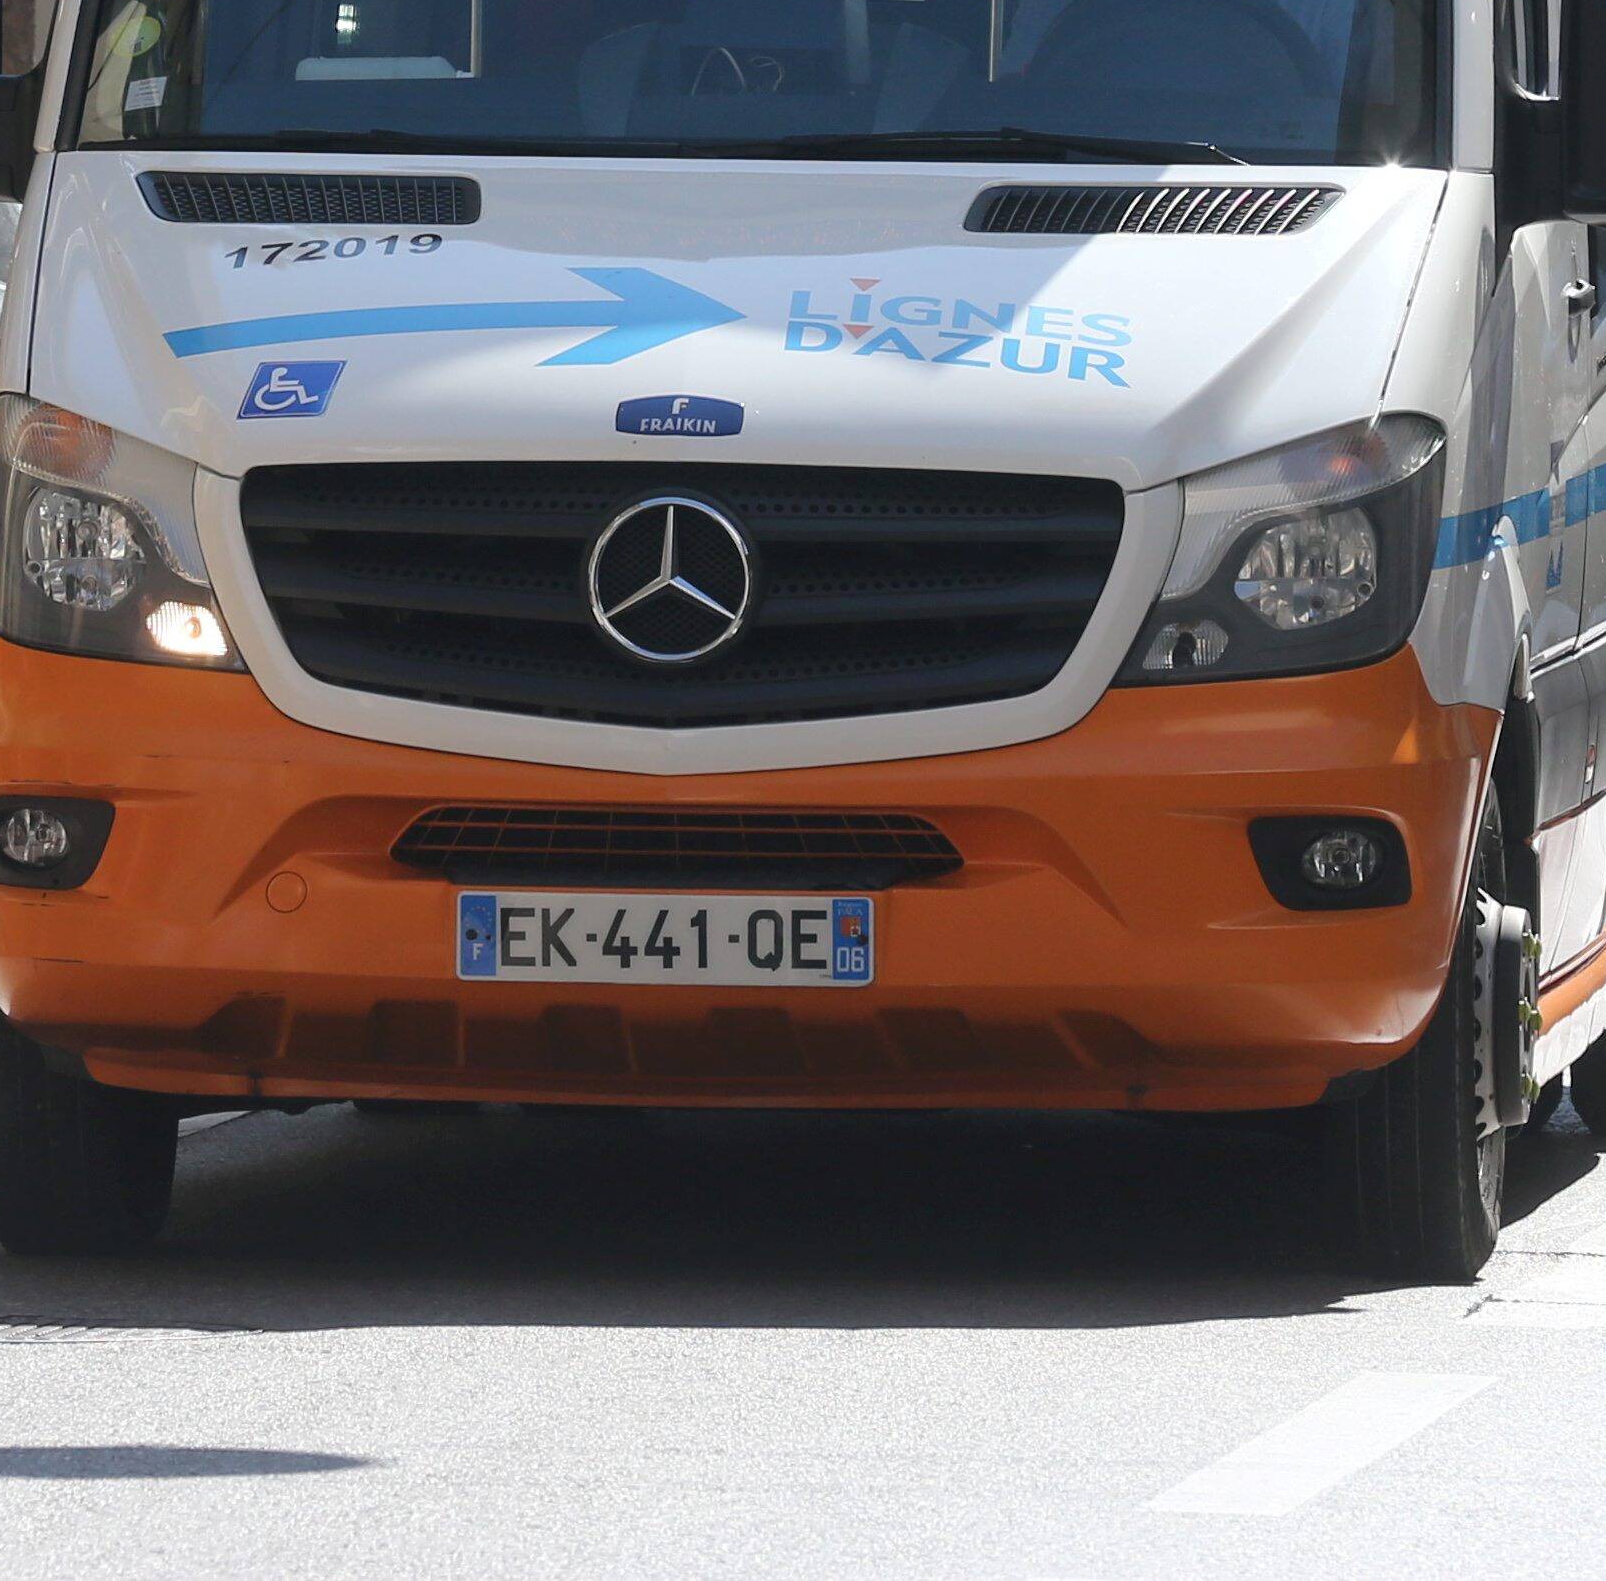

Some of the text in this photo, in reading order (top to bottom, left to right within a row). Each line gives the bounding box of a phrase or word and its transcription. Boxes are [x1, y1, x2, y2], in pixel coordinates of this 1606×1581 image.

[224, 233, 443, 269] 172019
[789, 278, 1133, 347] LIGNES
[639, 417, 717, 434] FRAIKIN
[499, 907, 828, 972] EK-441-QE
[836, 945, 865, 974] 06
